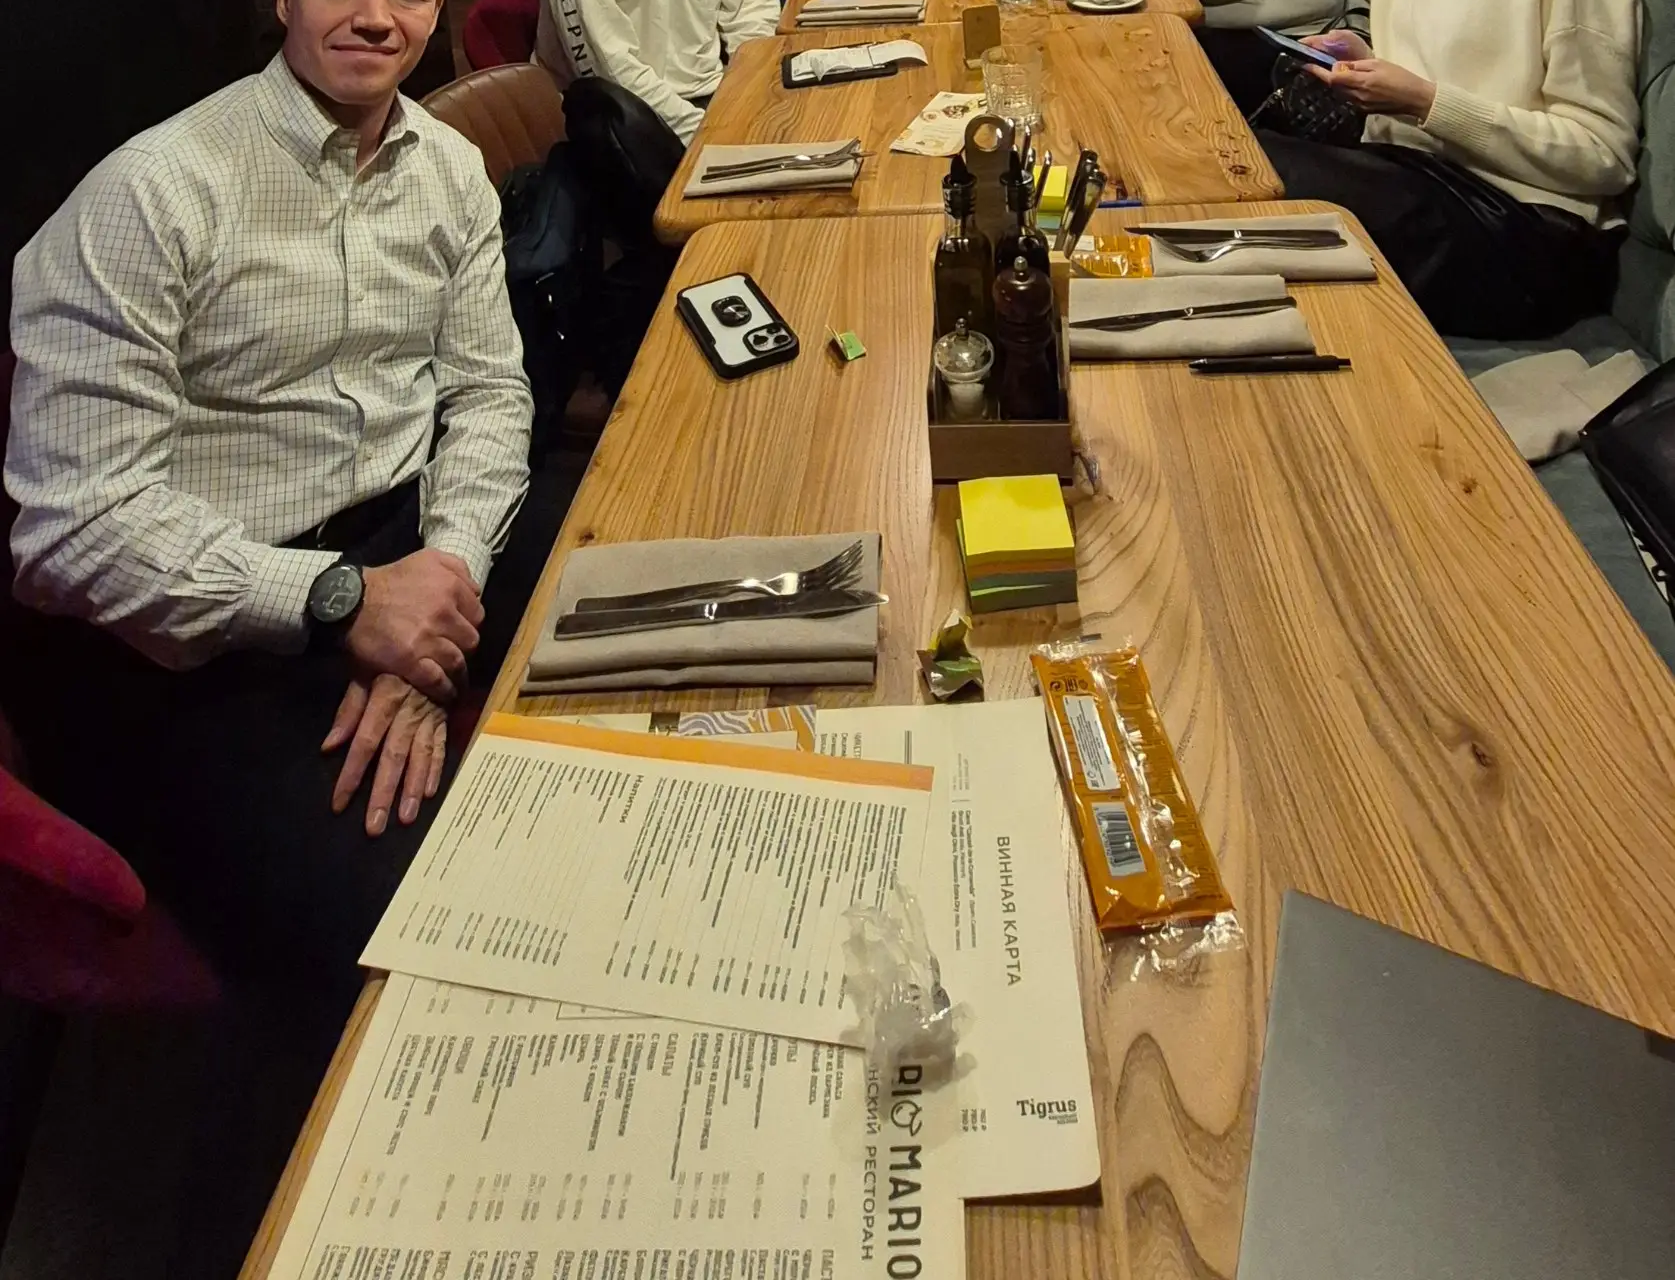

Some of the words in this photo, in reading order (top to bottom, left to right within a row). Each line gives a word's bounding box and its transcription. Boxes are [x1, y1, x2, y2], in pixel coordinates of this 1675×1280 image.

[619, 775, 644, 823] Напитки
[997, 837, 1016, 913] ВИННАЯ
[1004, 920, 1021, 986] КАРТА
[1017, 1099, 1076, 1119] Tigrus
[862, 1146, 878, 1260] РЕСТОРАН
[887, 1145, 923, 1280] MARIO
